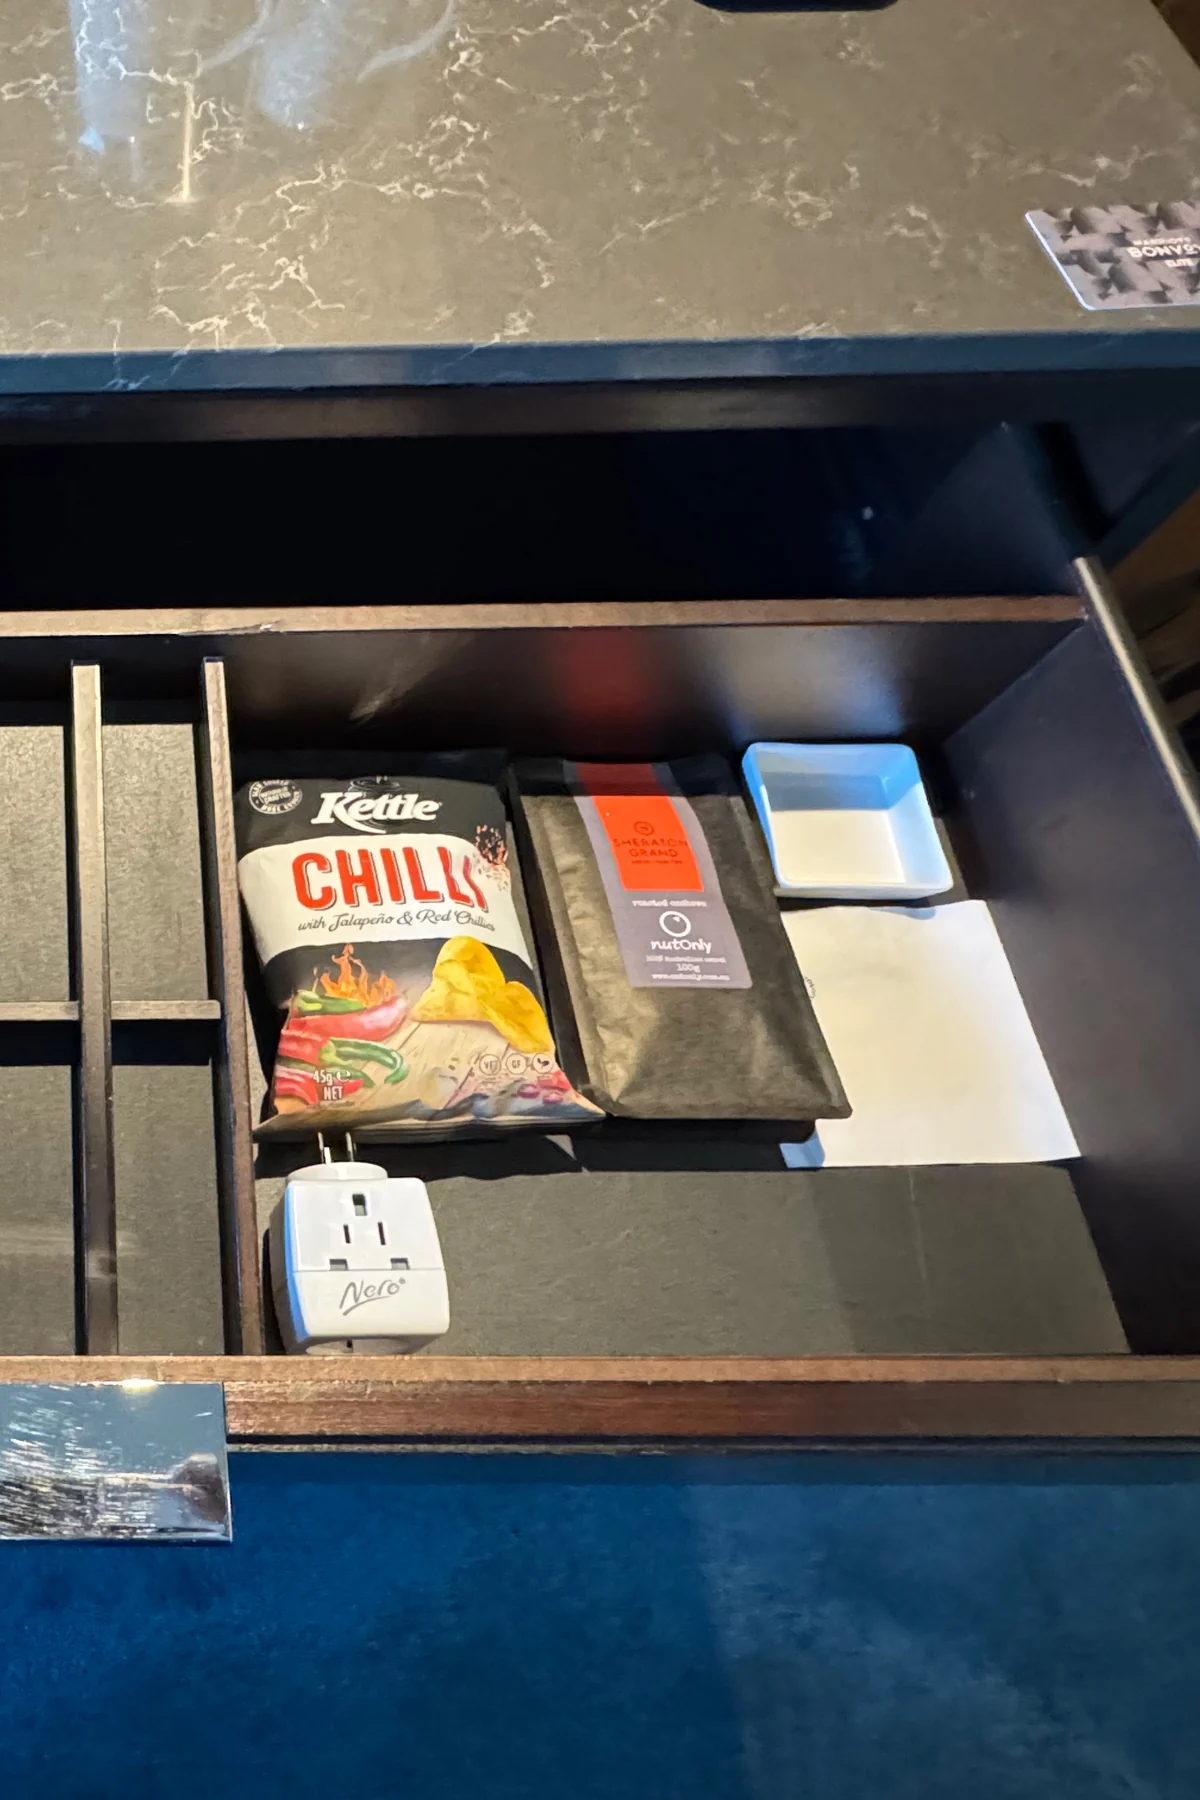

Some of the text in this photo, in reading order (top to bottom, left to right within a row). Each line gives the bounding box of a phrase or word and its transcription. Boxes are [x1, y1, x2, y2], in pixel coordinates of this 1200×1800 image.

[311, 791, 440, 834] Kettle
[613, 837, 688, 848] SHERATON
[629, 848, 678, 858] GRAND
[292, 846, 489, 912] CHILLI
[298, 909, 496, 932] with Jalapeño & Red Chillies
[650, 938, 712, 954] nutOnly
[676, 963, 701, 973] 100g
[313, 1069, 333, 1086] 45g
[323, 1085, 344, 1100] NET
[339, 1278, 401, 1311] Nero
